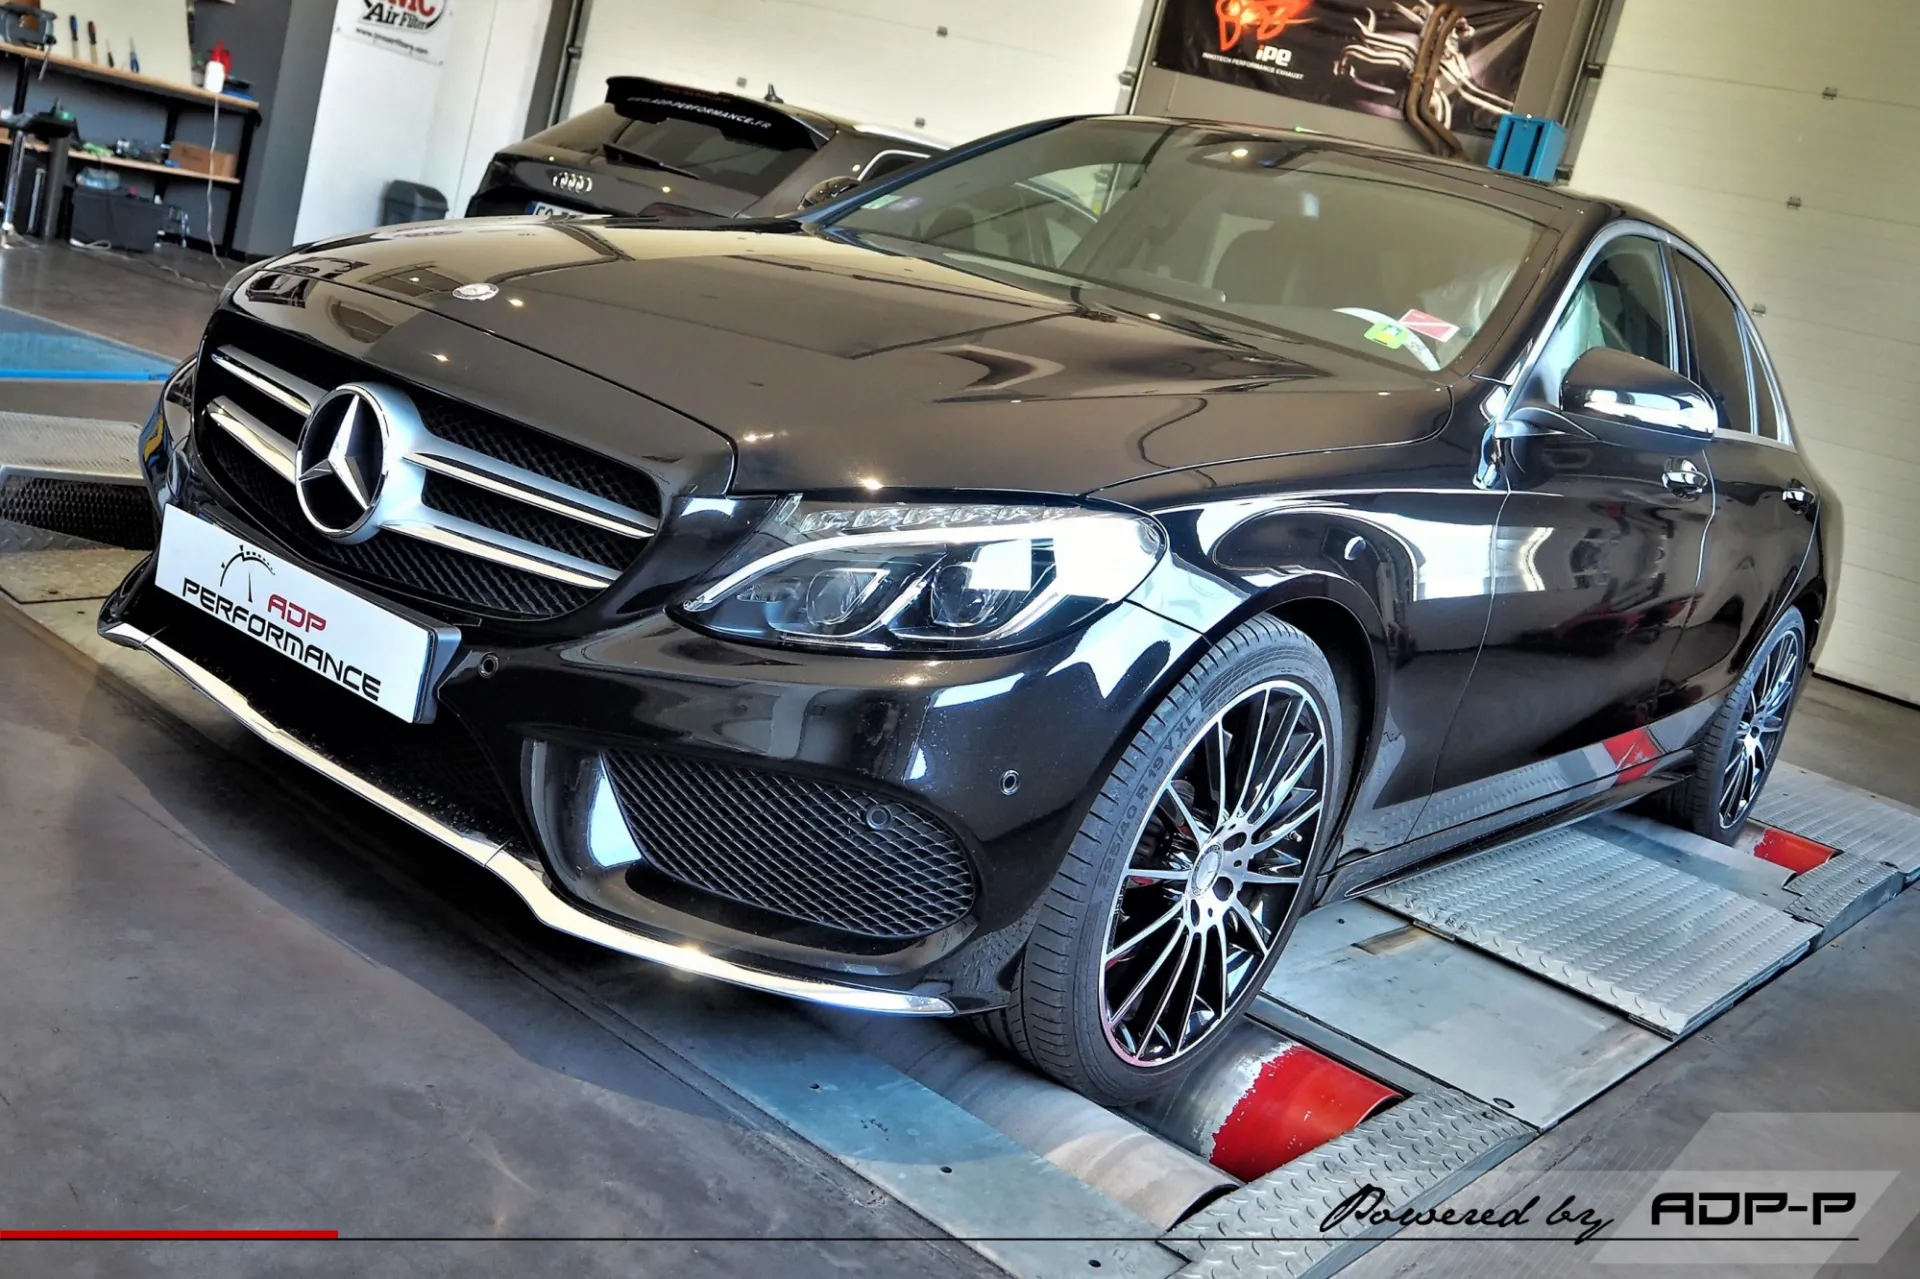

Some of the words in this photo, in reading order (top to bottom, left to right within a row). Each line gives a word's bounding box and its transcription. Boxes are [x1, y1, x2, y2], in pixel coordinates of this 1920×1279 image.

[362, 2, 399, 25] Air
[1231, 58, 1275, 73] PERFORMANCE
[1275, 67, 1304, 80] EXHAUST
[267, 593, 327, 633] ADP
[182, 577, 381, 702] PERFORMANCE
[1147, 755, 1165, 779] 19
[1175, 715, 1196, 737] XL
